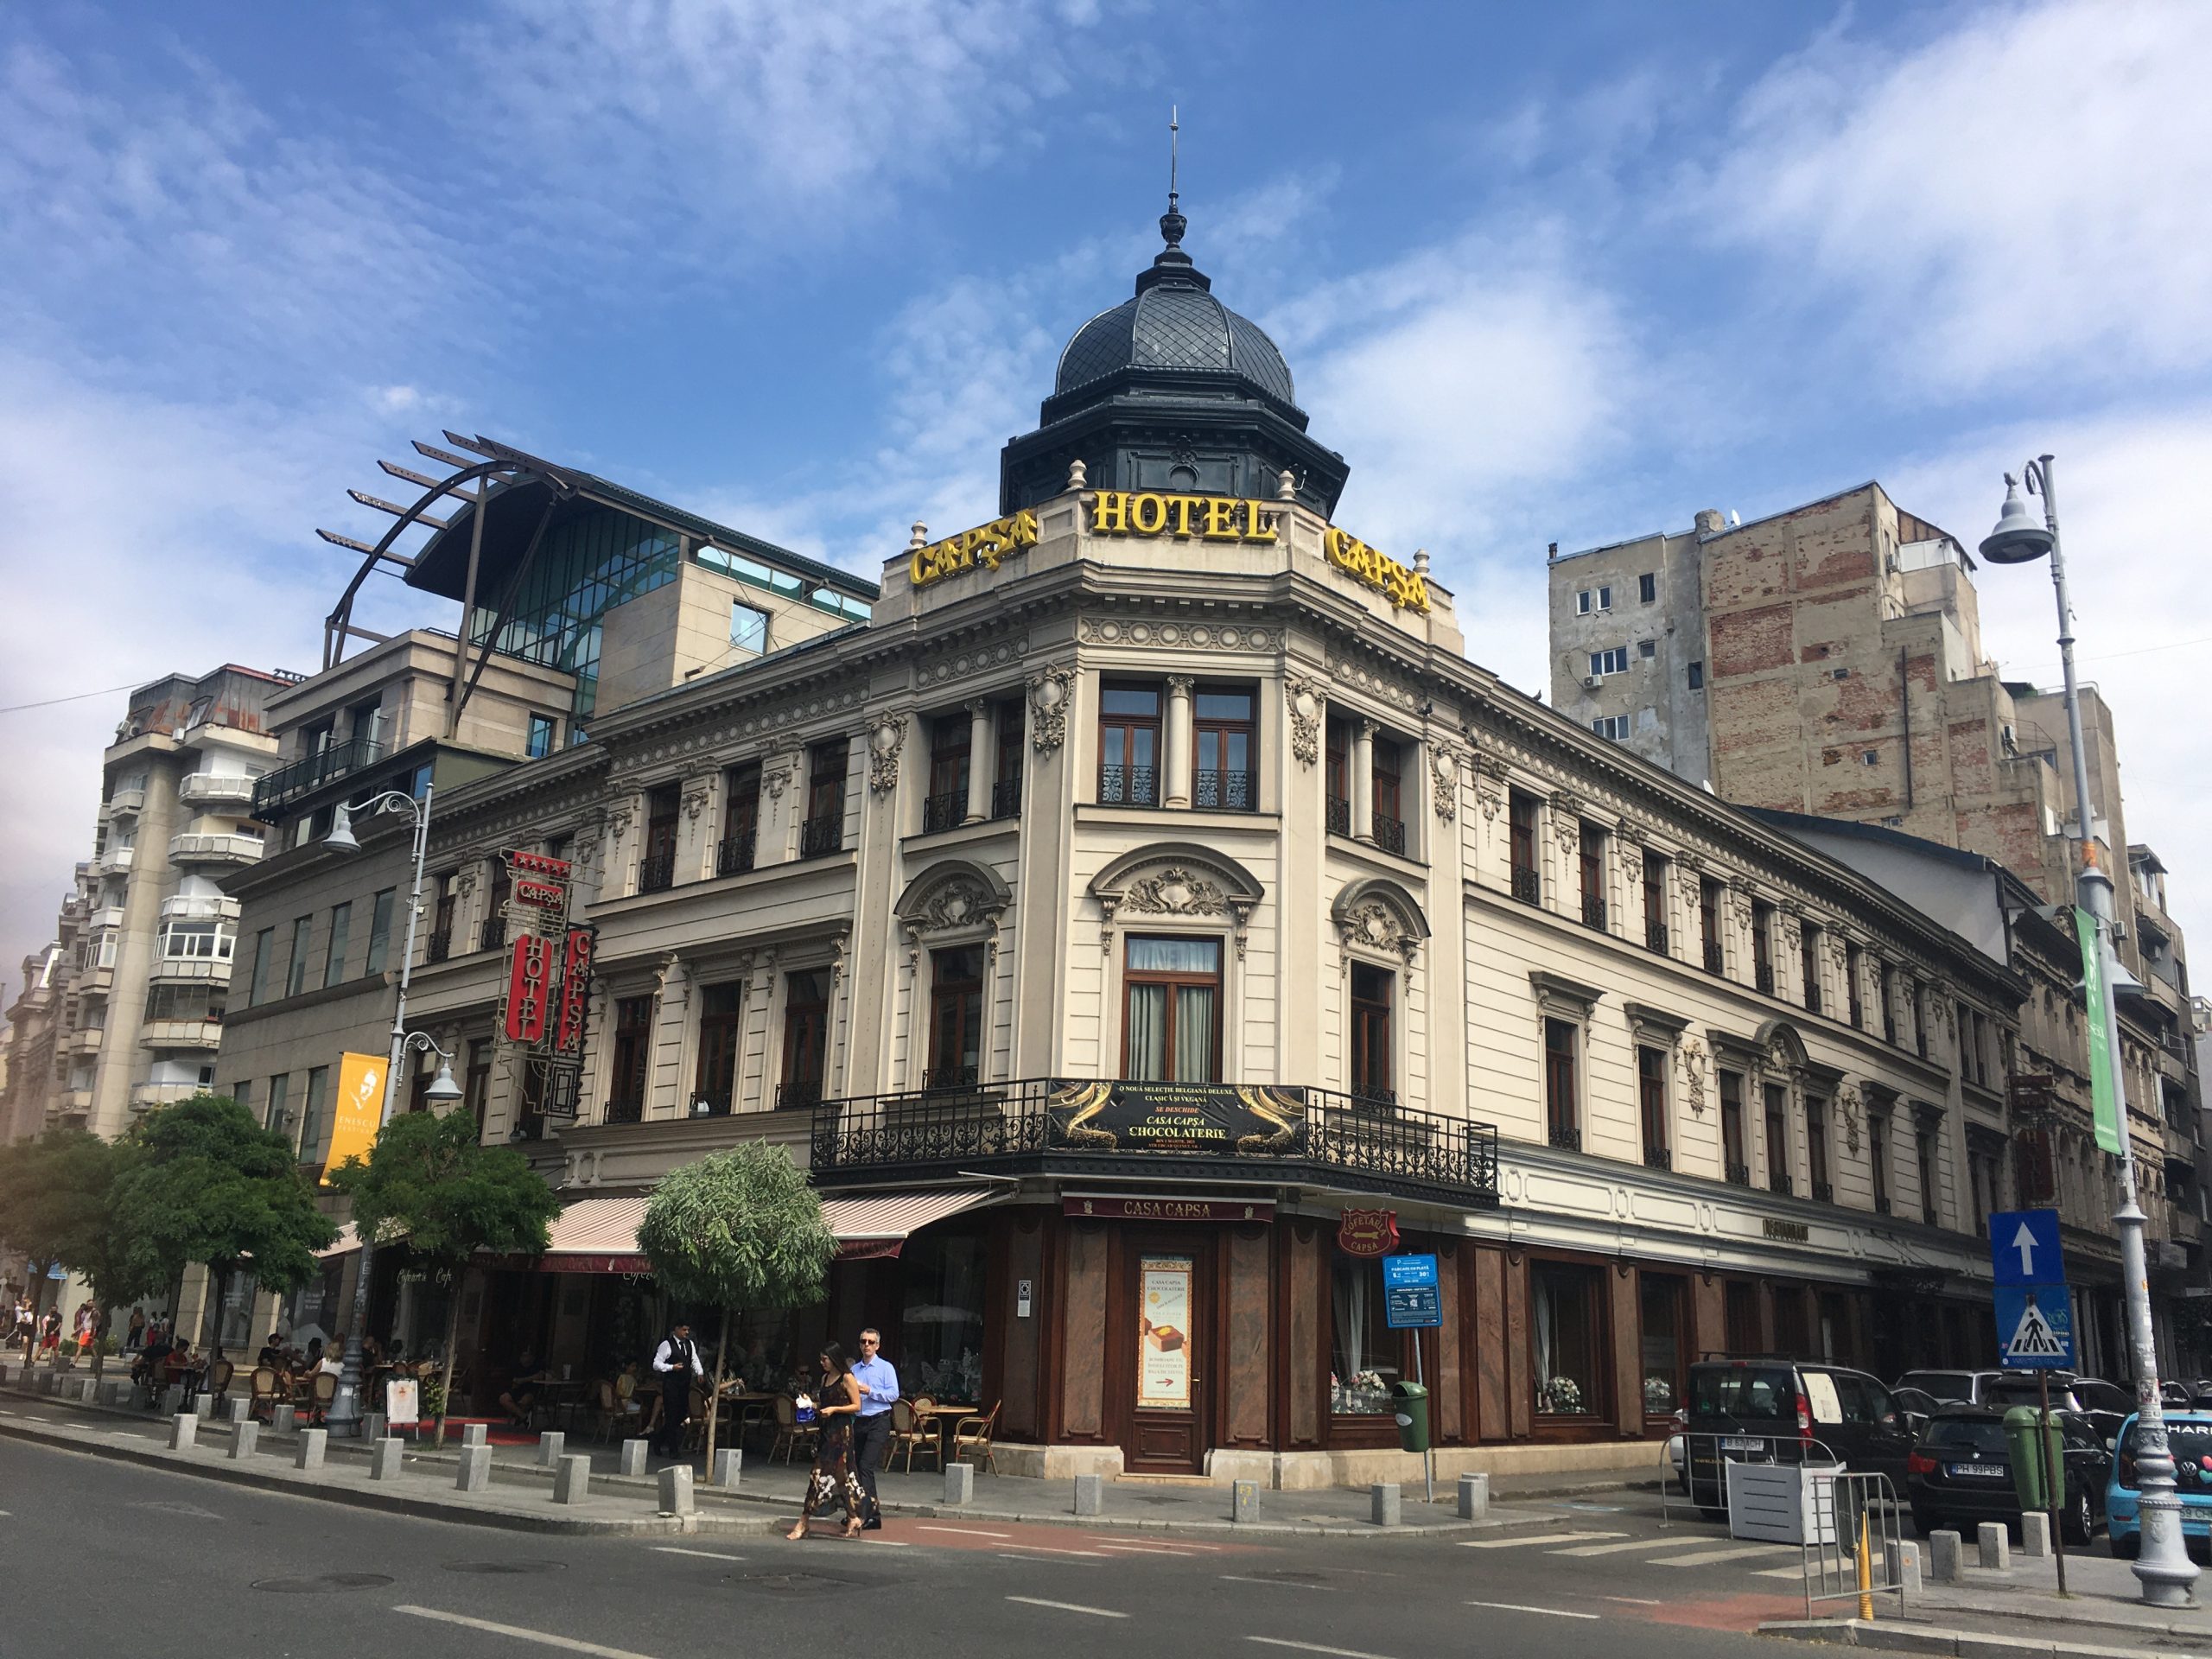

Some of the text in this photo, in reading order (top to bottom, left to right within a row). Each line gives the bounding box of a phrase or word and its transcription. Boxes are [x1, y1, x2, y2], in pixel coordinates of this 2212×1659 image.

[1093, 490, 1278, 543] HOTEL
[518, 937, 546, 1041] HOTEL
[339, 1116, 376, 1128] ENESCU
[1146, 1116, 1172, 1125] CASA
[1128, 1127, 1226, 1139] CHOCOLATERIE
[1124, 1201, 1211, 1217] CASA CAPSA
[2168, 1425, 2212, 1434] HAR
[1726, 1438, 1732, 1446] B
